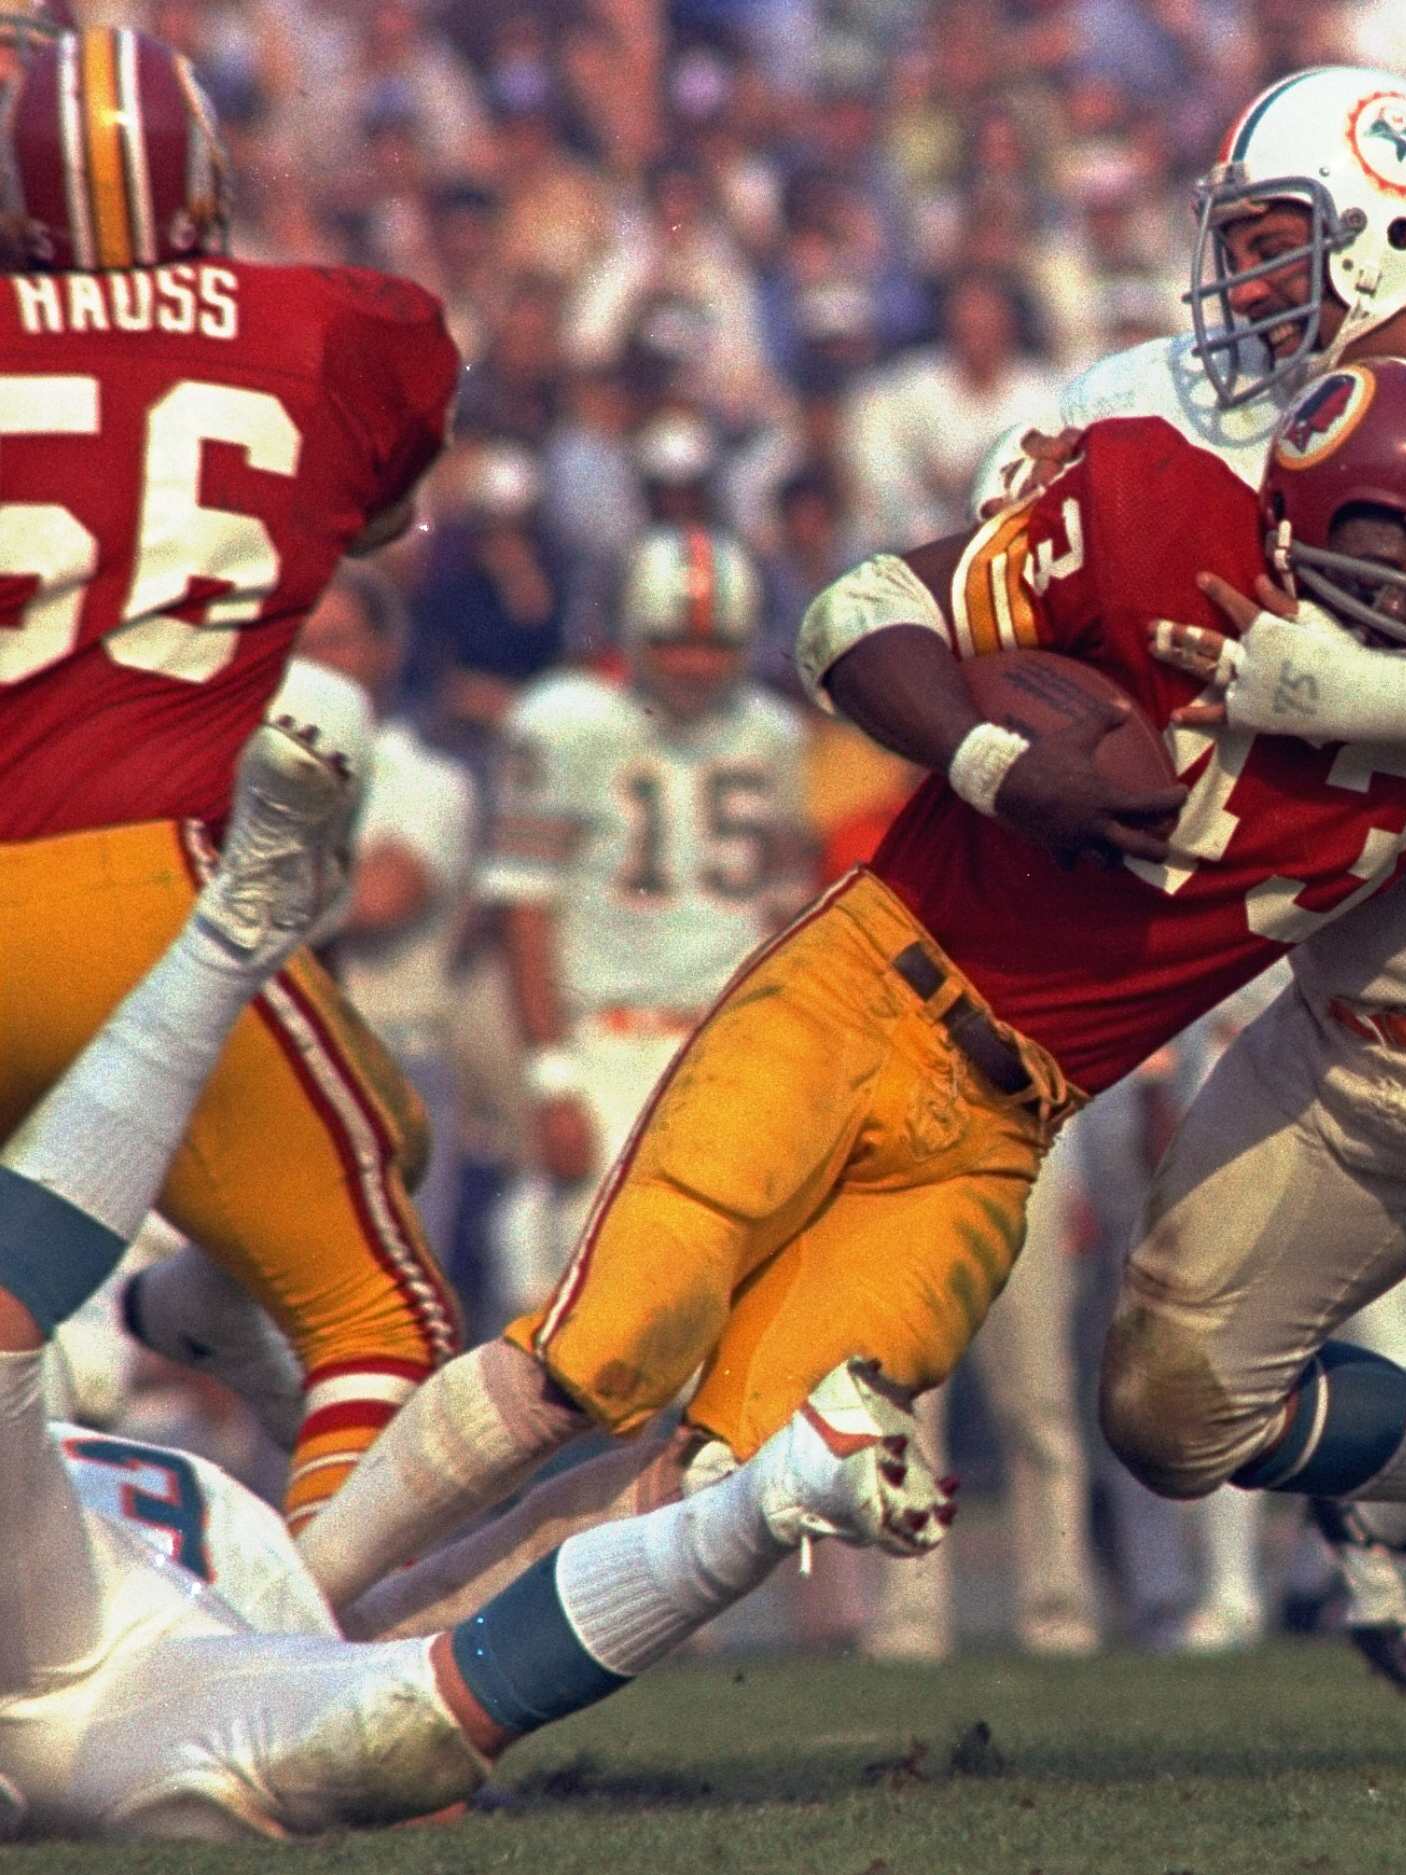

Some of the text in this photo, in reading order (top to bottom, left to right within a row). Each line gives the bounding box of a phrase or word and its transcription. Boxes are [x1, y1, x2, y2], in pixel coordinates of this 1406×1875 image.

[14, 264, 239, 340] HAUSS
[0, 372, 301, 684] 56
[1273, 659, 1318, 716] 75
[622, 765, 770, 898] 15
